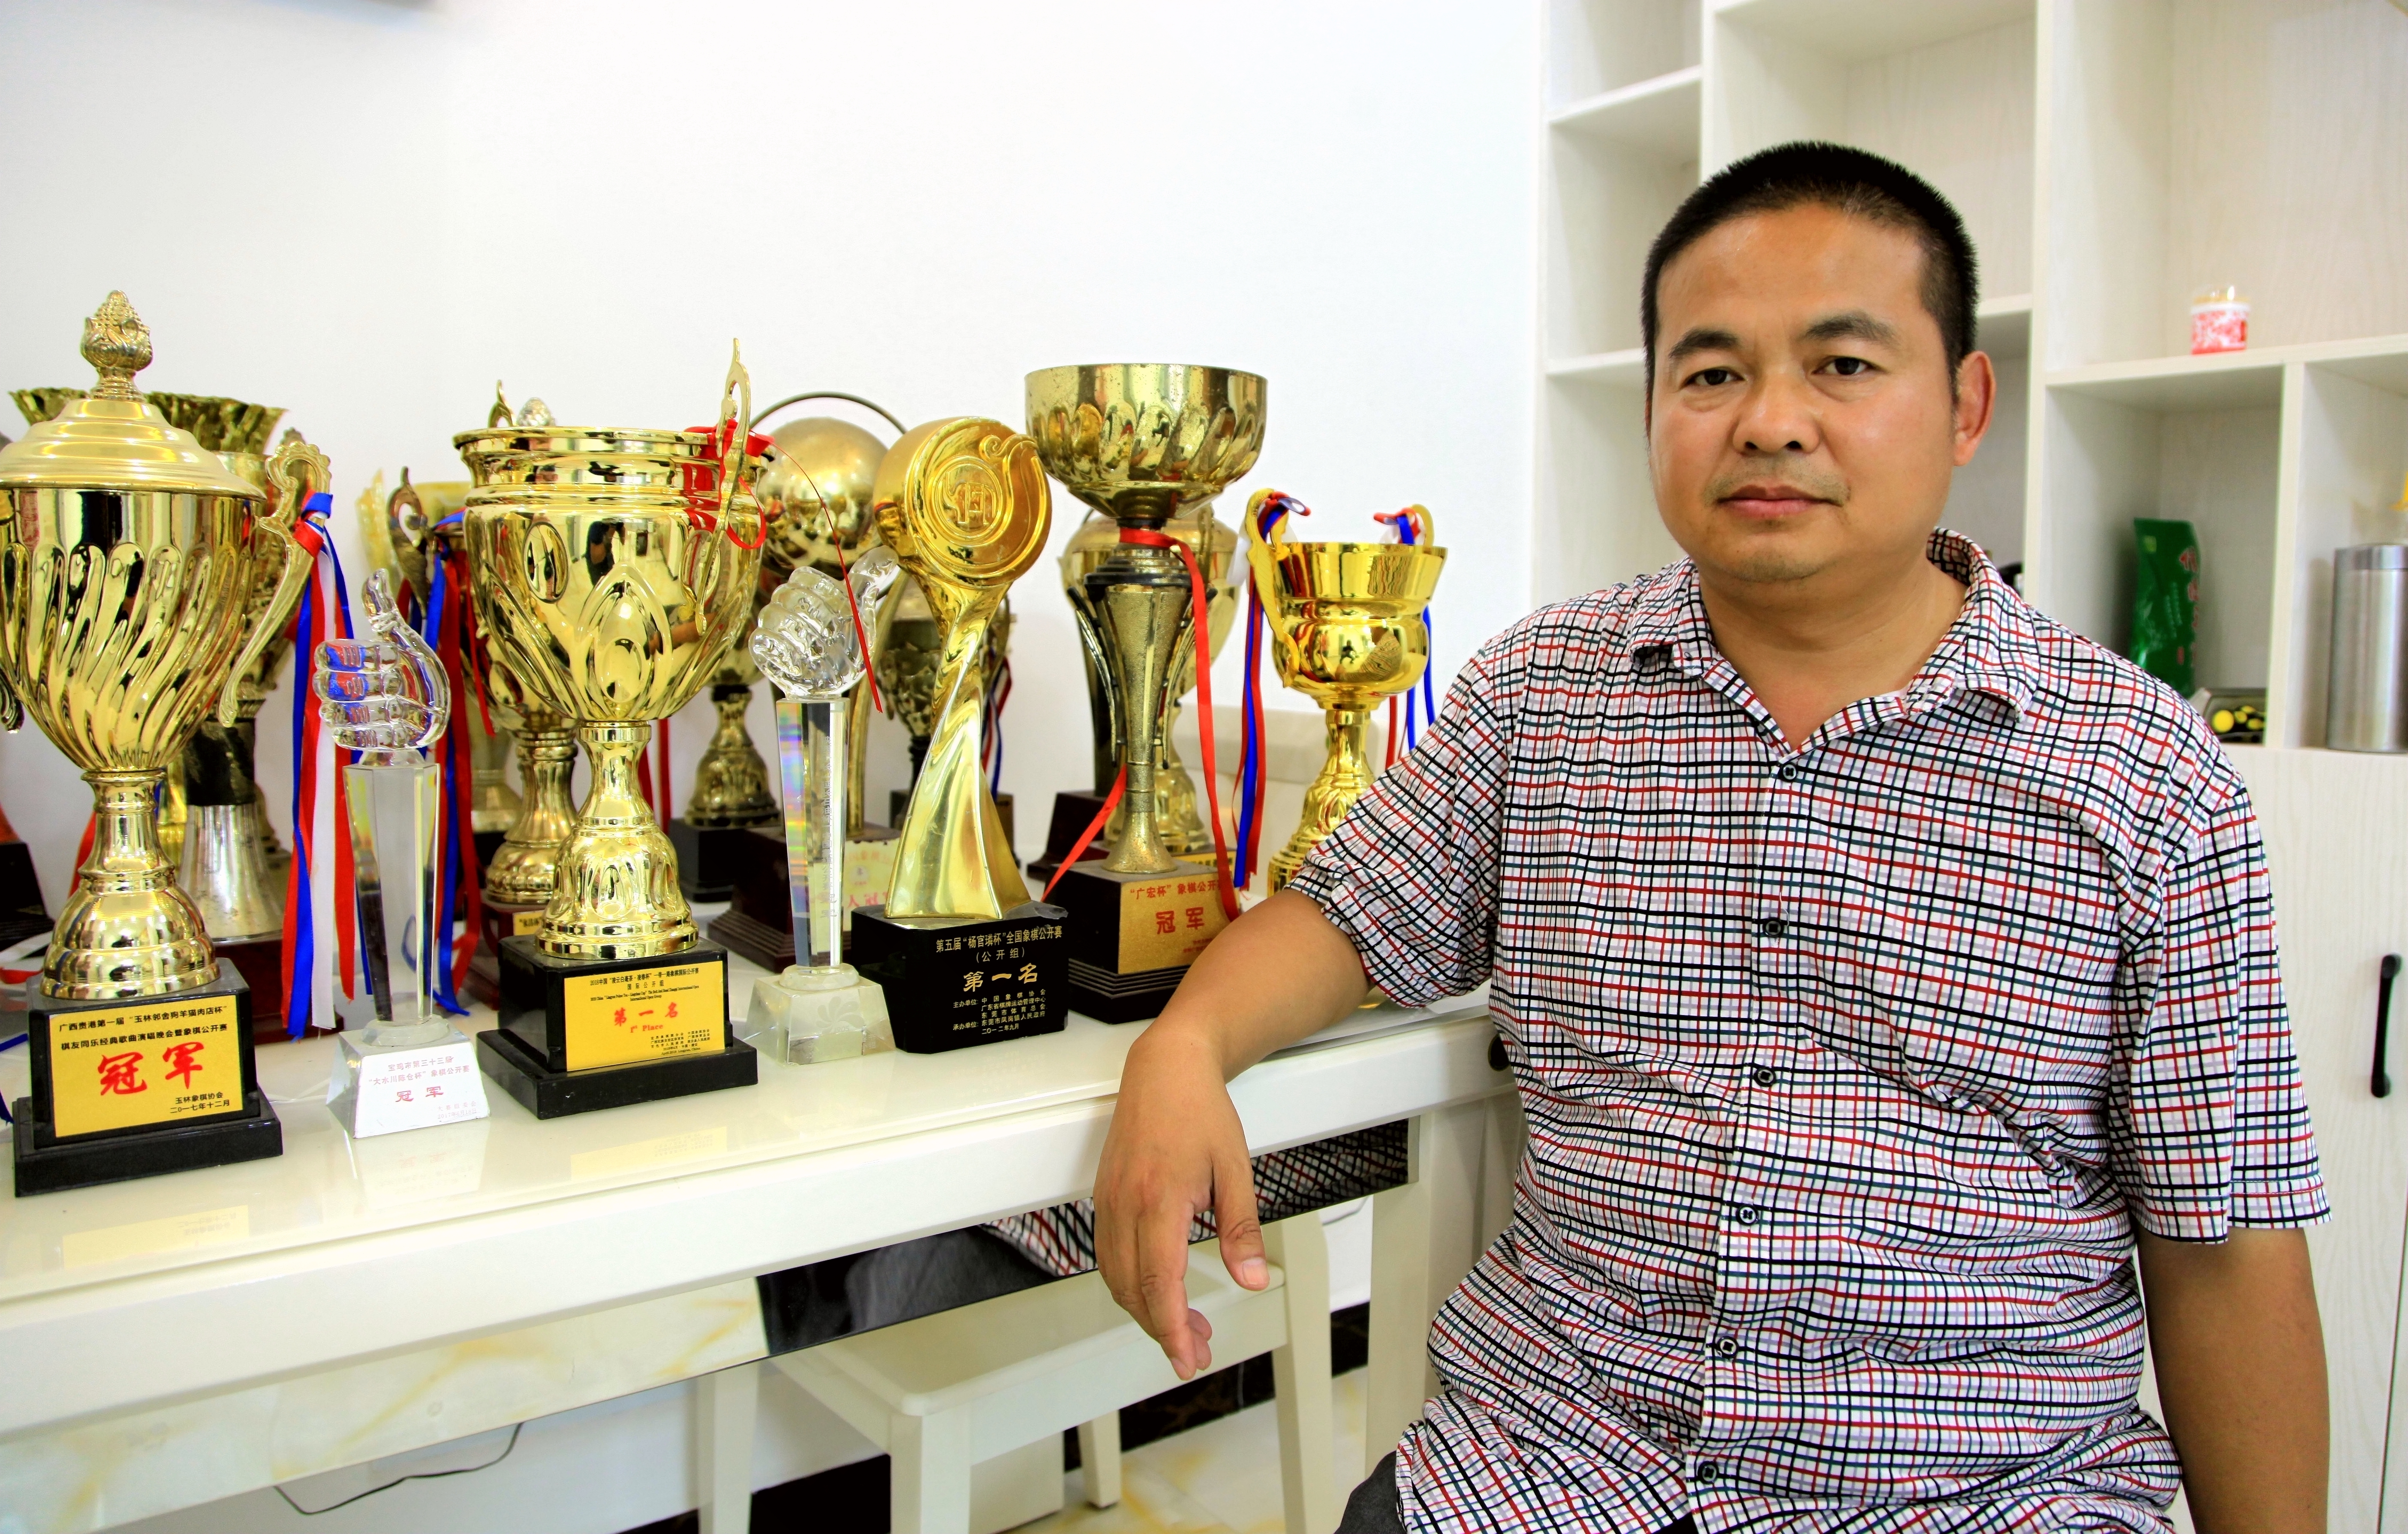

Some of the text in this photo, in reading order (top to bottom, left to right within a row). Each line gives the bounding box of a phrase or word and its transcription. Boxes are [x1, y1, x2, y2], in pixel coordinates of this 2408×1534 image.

[1156, 906, 1205, 934] 冠军
[627, 980, 665, 990] 国际公开组
[963, 963, 1038, 992] 第一名
[981, 989, 1046, 1004] 中国象棋协会
[981, 996, 1046, 1012] 广东省棋牌运动管理中心
[614, 1002, 678, 1027] 第一名
[981, 1004, 1046, 1019] 东莞市体育总会
[981, 1011, 1045, 1026] 东莞市凤岗镇人民政府
[61, 1023, 228, 1050] 棋友同乐经典歌曲演唱晚会暨象棋公开赛
[97, 1042, 205, 1096] 冠军
[388, 1056, 455, 1072] 宝鸡市第三十三届
[175, 1091, 223, 1104] 玉林象棋协会
[395, 1085, 444, 1103] 冠军
